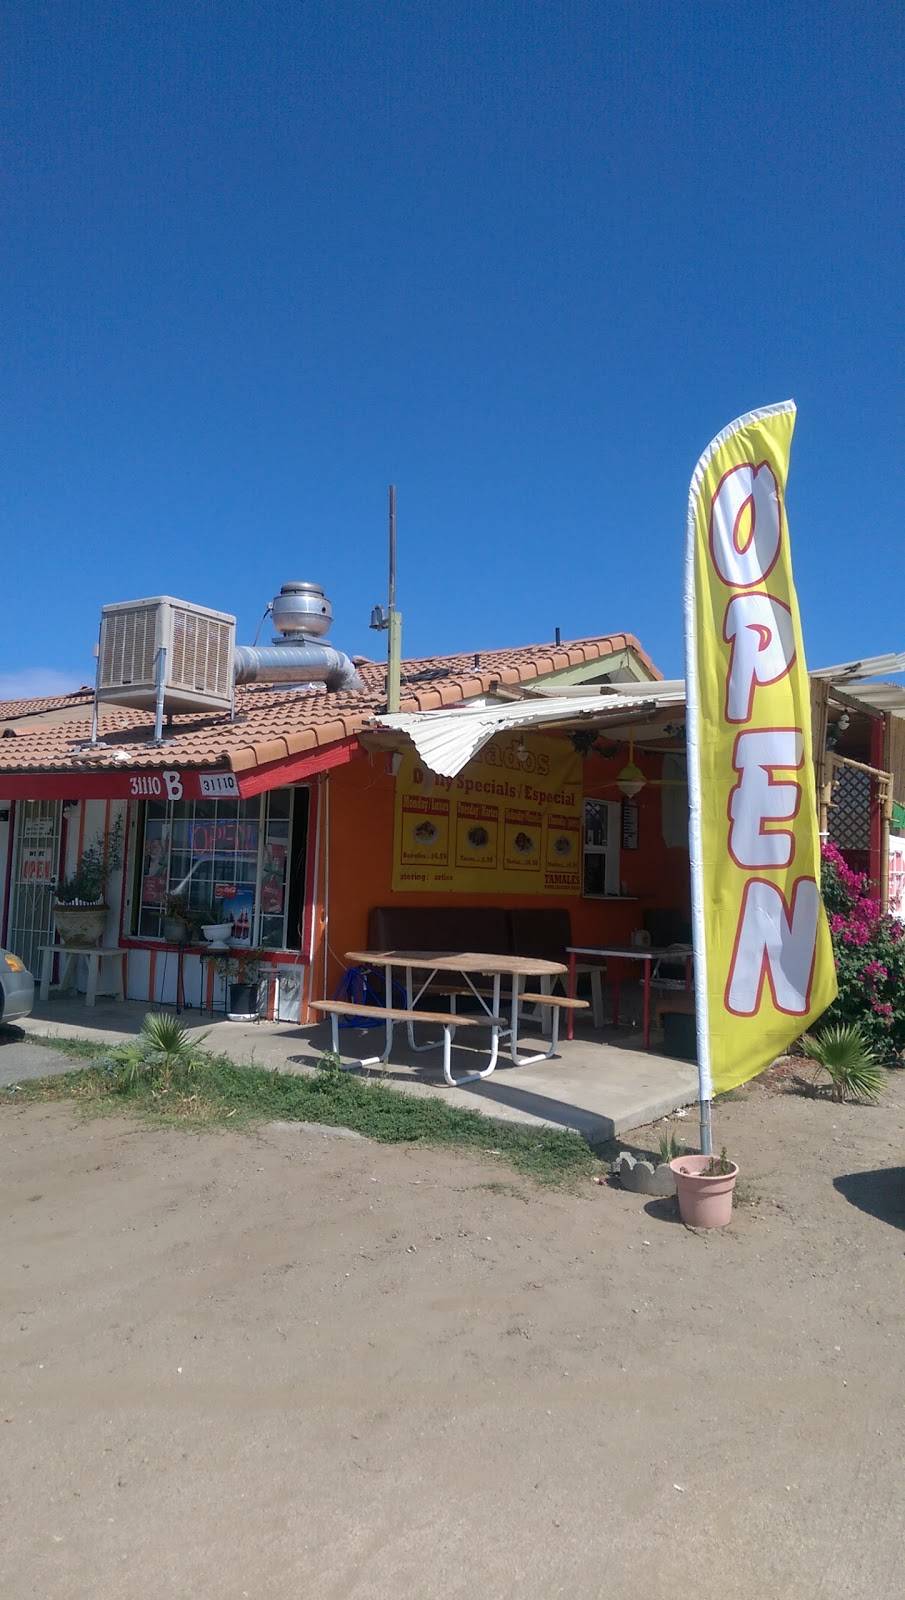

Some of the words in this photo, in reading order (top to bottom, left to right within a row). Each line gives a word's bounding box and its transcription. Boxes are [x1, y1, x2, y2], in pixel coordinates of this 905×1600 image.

[709, 462, 819, 1017] OPEN
[129, 776, 161, 795] 31110
[162, 770, 183, 800] B
[203, 776, 234, 791] 31110
[23, 860, 51, 880] OPEN
